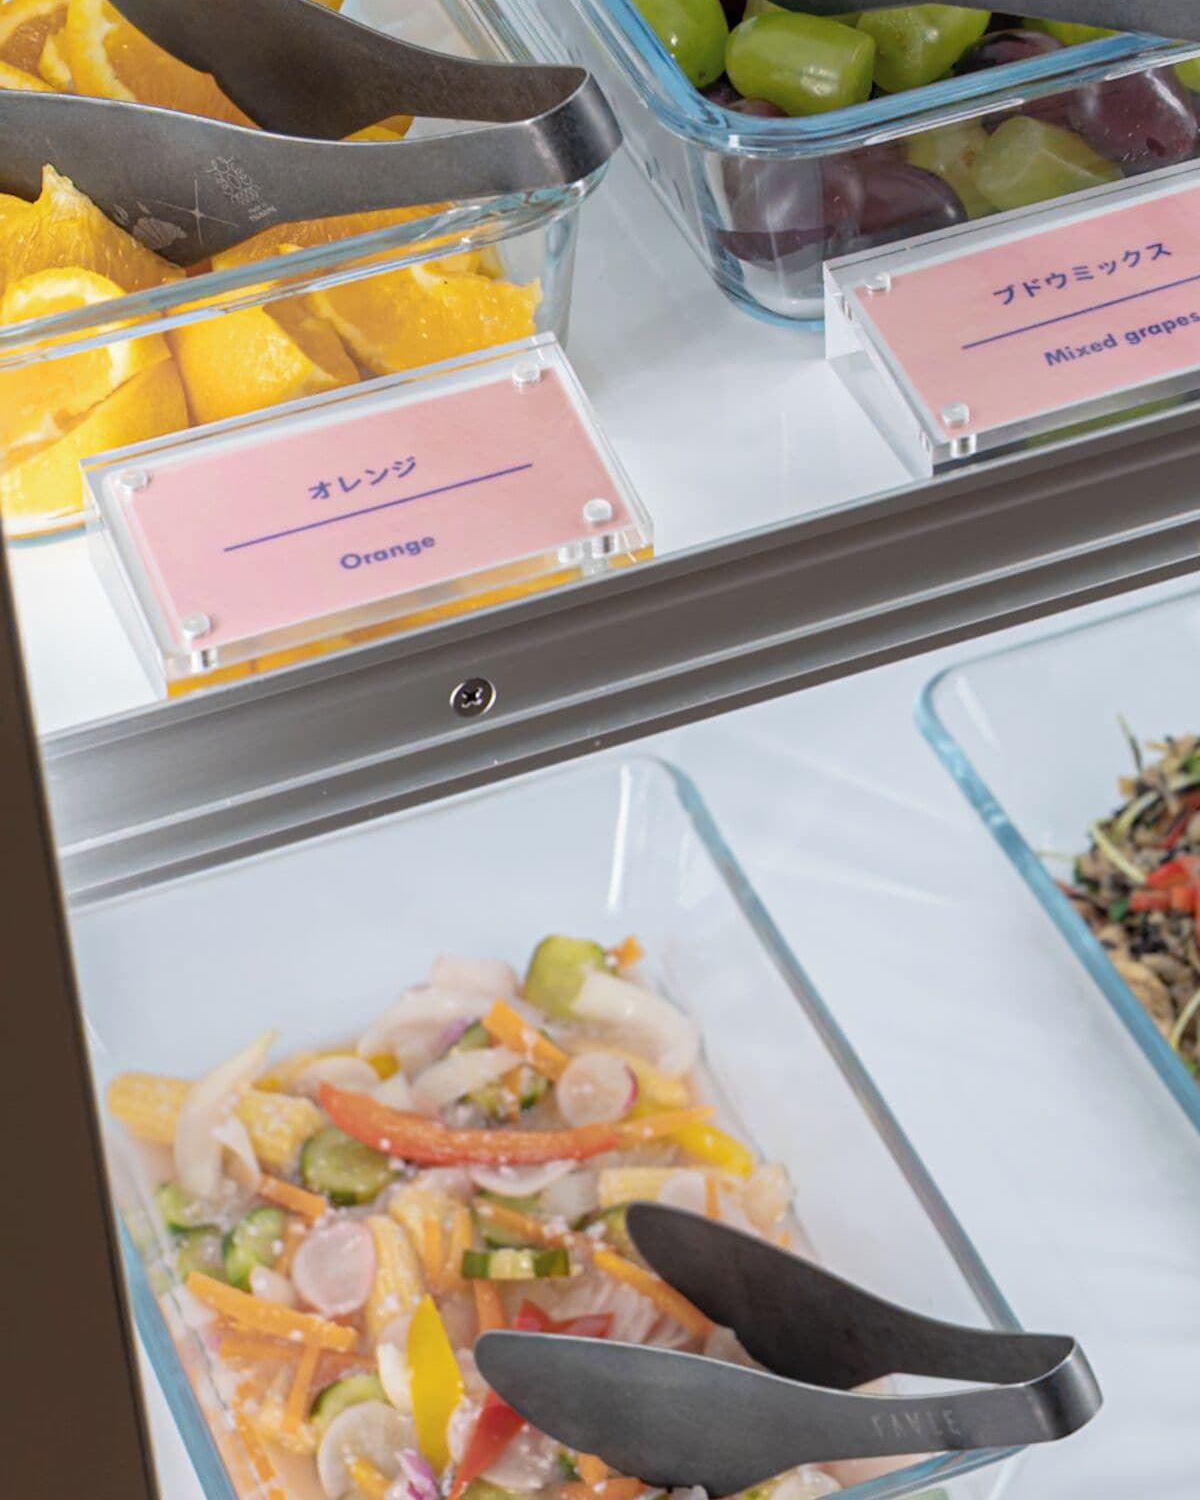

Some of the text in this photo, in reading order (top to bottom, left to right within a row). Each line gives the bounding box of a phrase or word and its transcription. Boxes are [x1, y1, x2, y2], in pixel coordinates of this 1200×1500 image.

[992, 243, 1172, 305] ブドウミックス
[1044, 333, 1119, 366] Mixed
[308, 456, 416, 499] オレンジ
[340, 536, 435, 569] Orange
